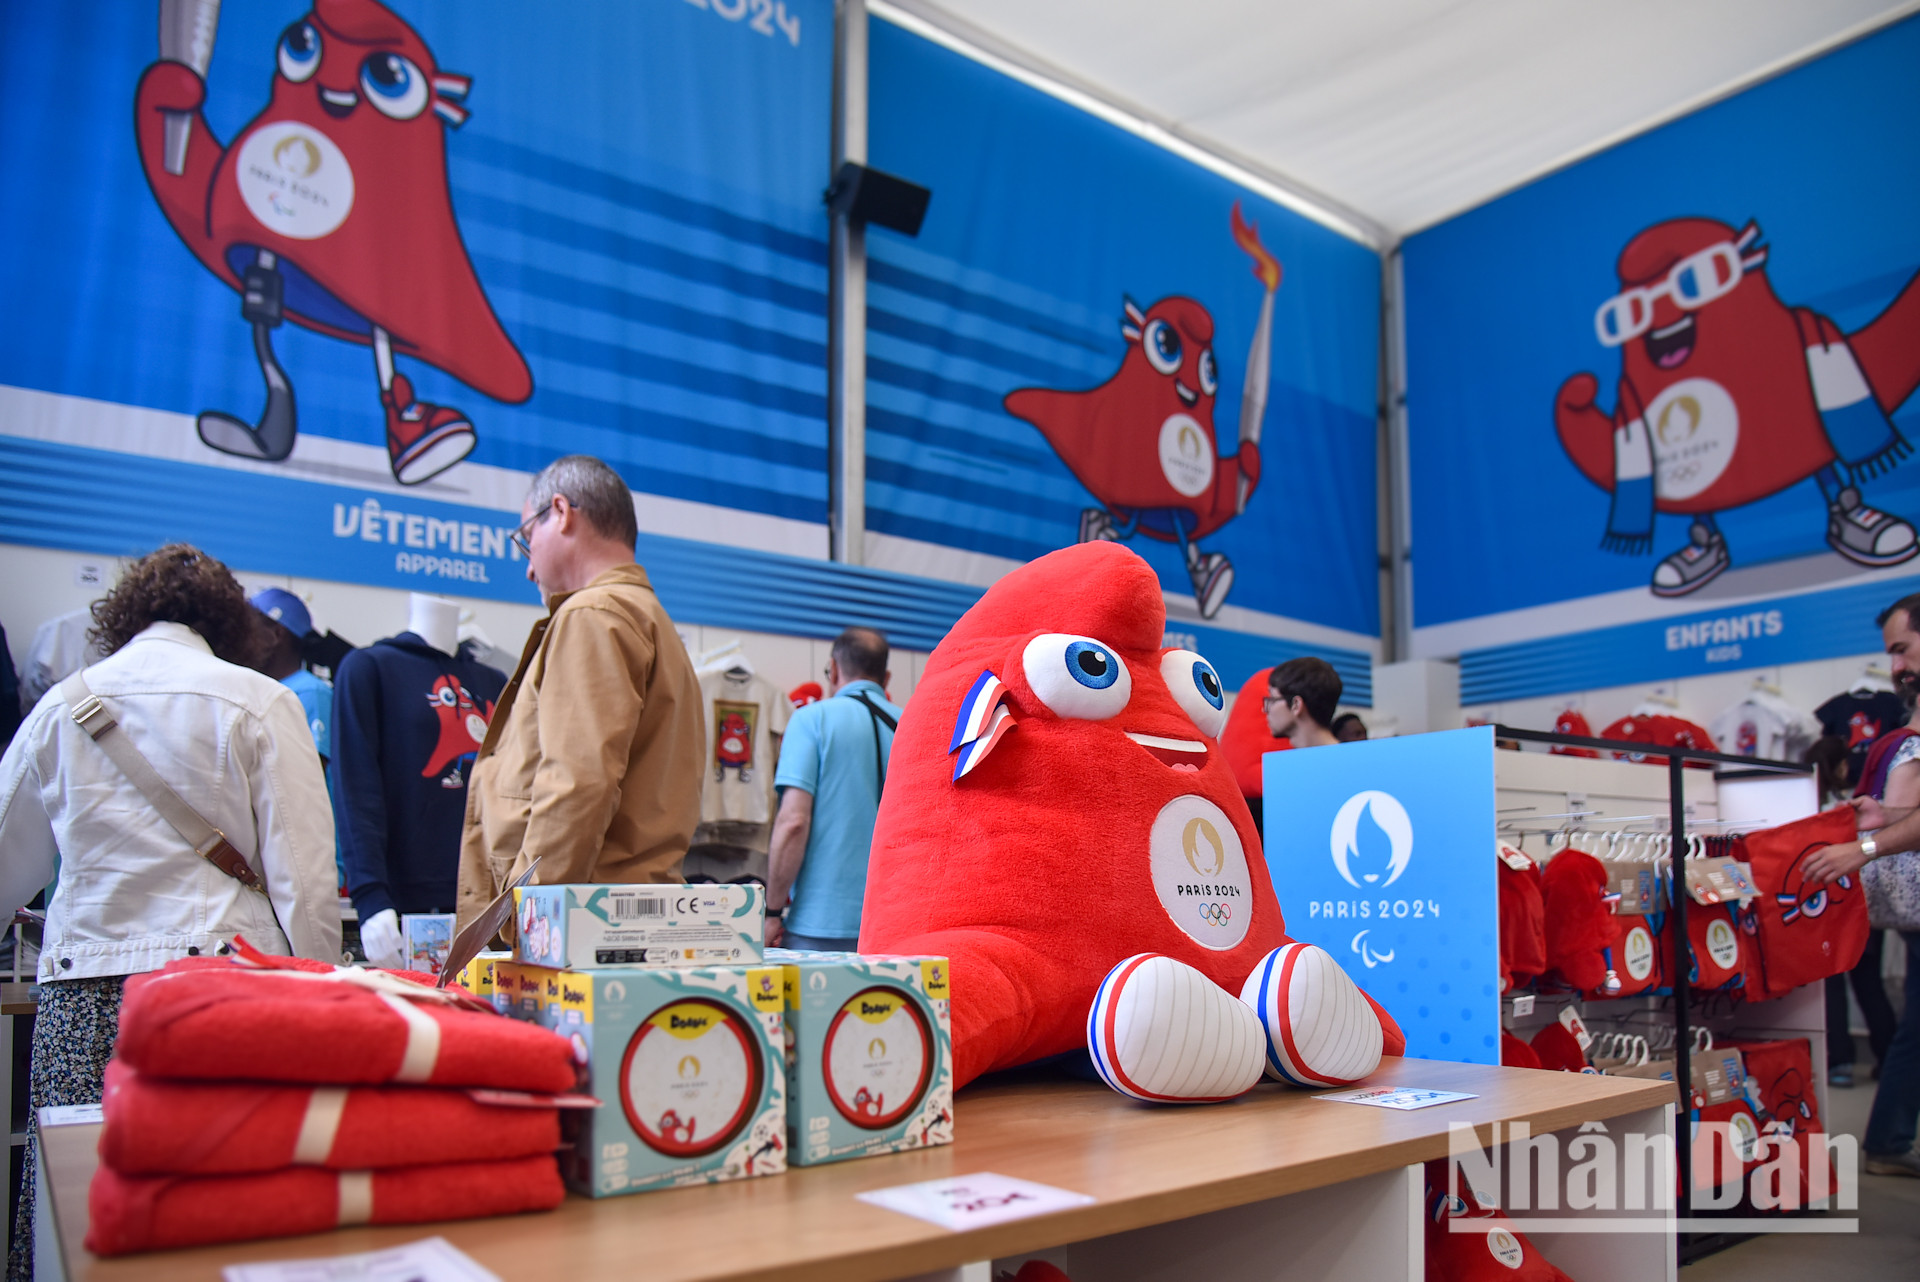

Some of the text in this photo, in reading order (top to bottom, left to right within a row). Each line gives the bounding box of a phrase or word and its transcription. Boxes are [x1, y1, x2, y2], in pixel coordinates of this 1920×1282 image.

[684, 0, 800, 47] 024
[395, 552, 490, 584] APPAREL
[1665, 610, 1783, 651] ENFANTS
[1214, 885, 1241, 897] 2024
[1378, 899, 1440, 919] 2024
